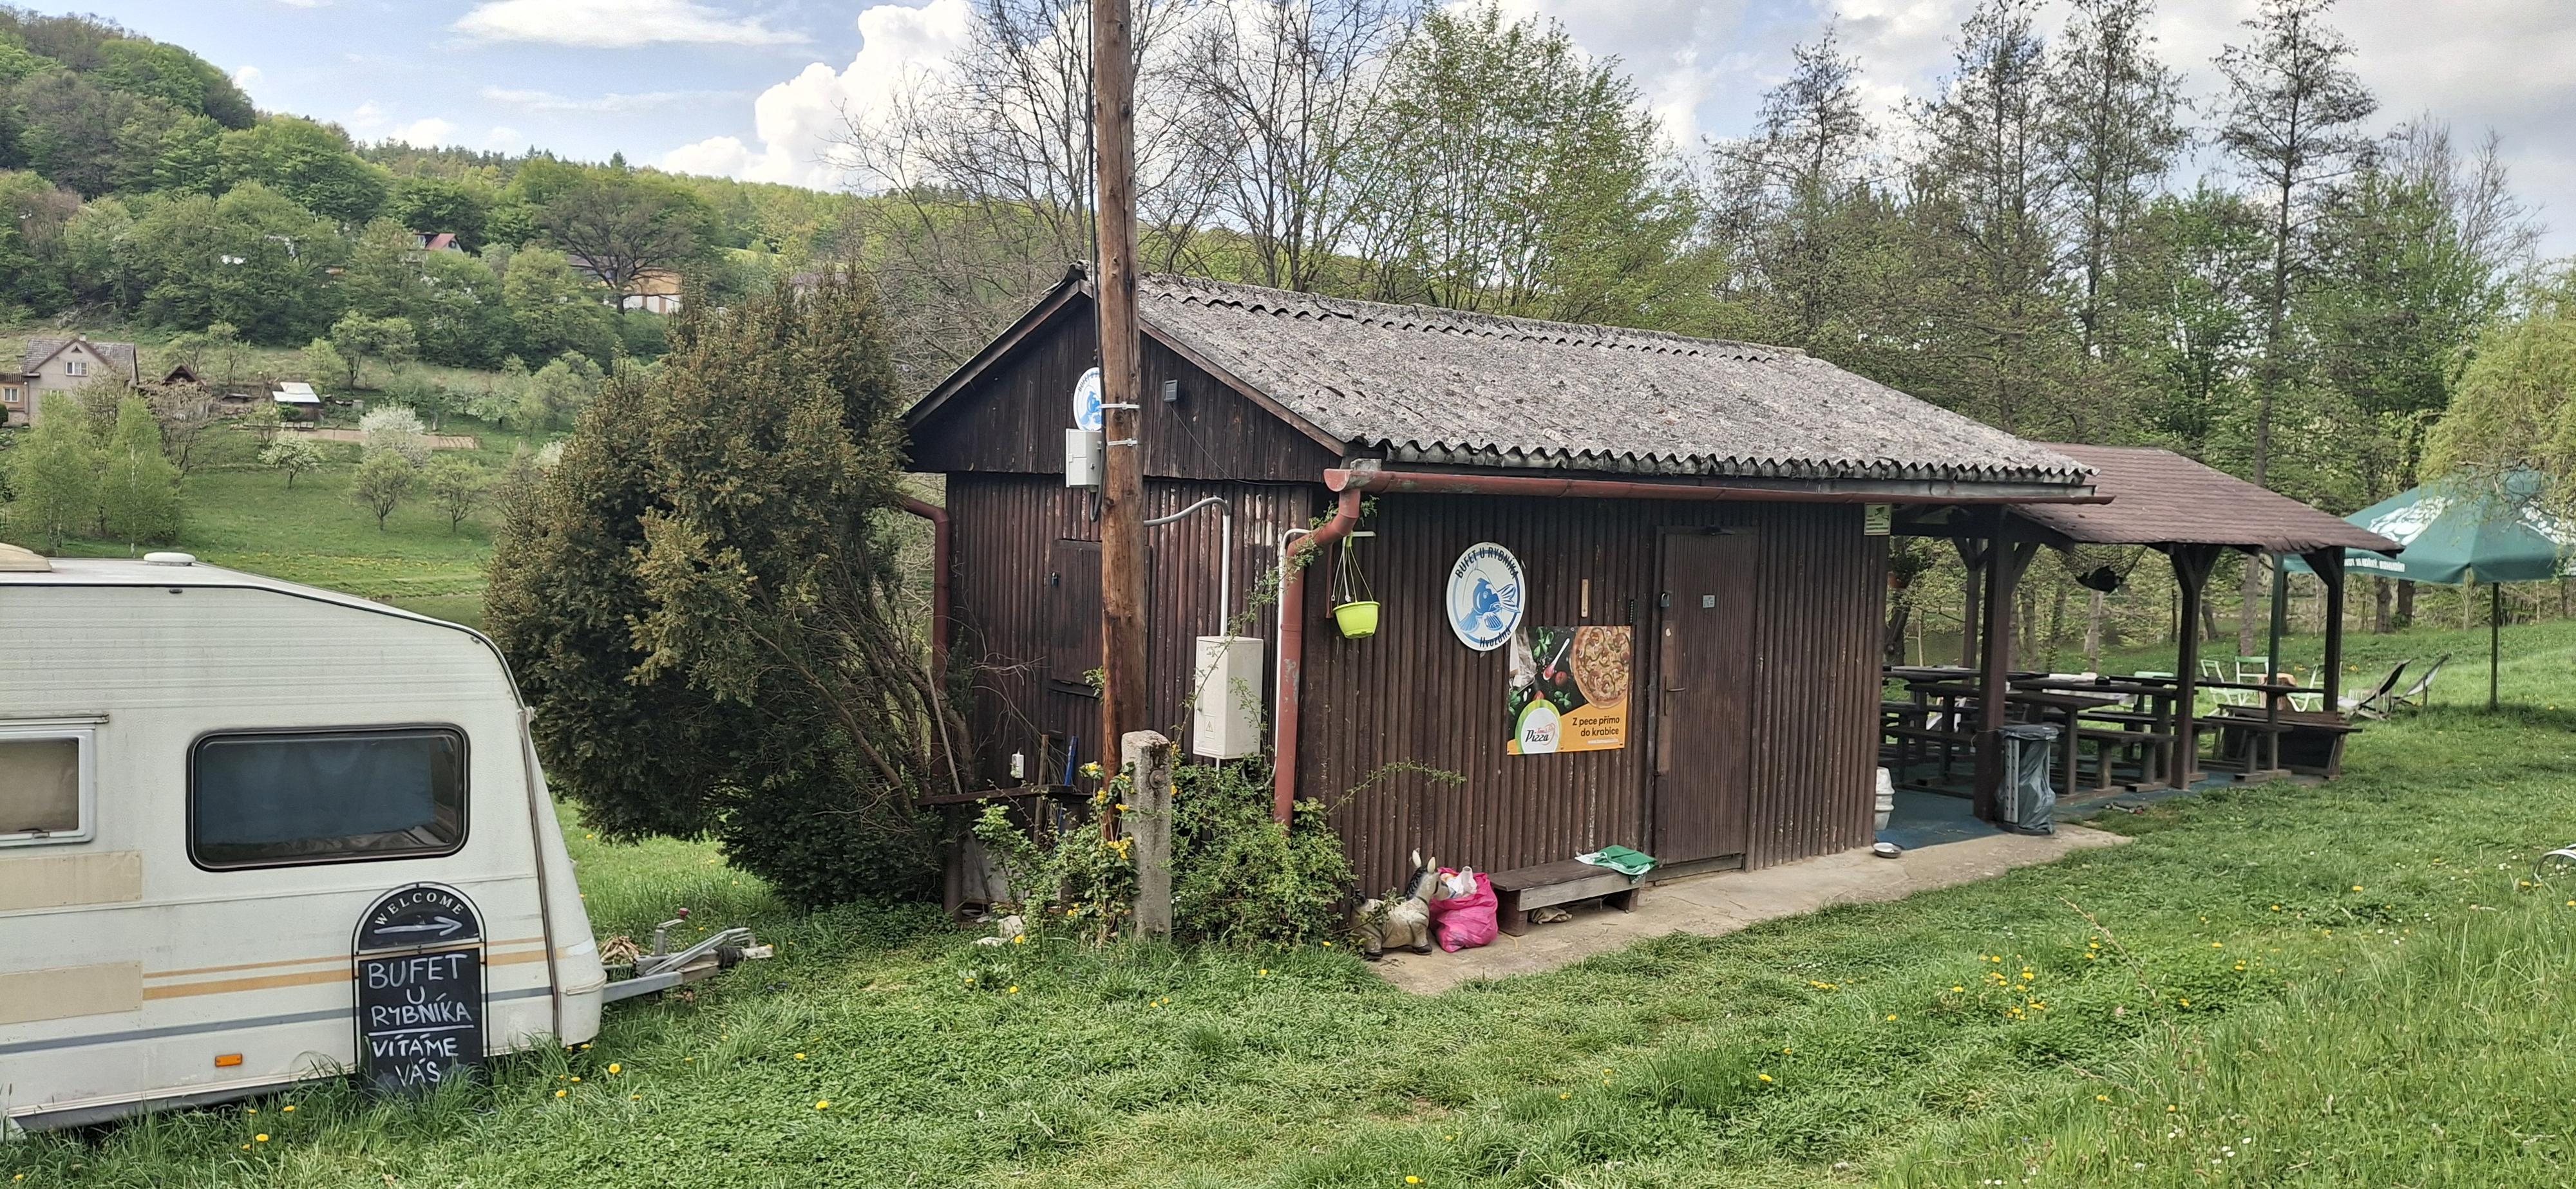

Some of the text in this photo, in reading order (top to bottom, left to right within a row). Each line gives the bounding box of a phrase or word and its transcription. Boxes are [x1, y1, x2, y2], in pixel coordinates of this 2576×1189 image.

[1455, 547, 1519, 579] BUFET U RYBNÍKA
[1479, 626, 1511, 648] Hvozdná
[1579, 718, 1597, 727] pece
[1598, 716, 1620, 726] přímo
[1580, 727, 1619, 736] do krabice
[1525, 729, 1550, 742] Pizza
[375, 892, 464, 926] WELCOME
[368, 953, 468, 989] BUFET
[406, 986, 425, 1005] U
[371, 993, 473, 1027] RYBNÍKA
[372, 1033, 459, 1058] VÍTÁME
[395, 1058, 440, 1087] VÁS
